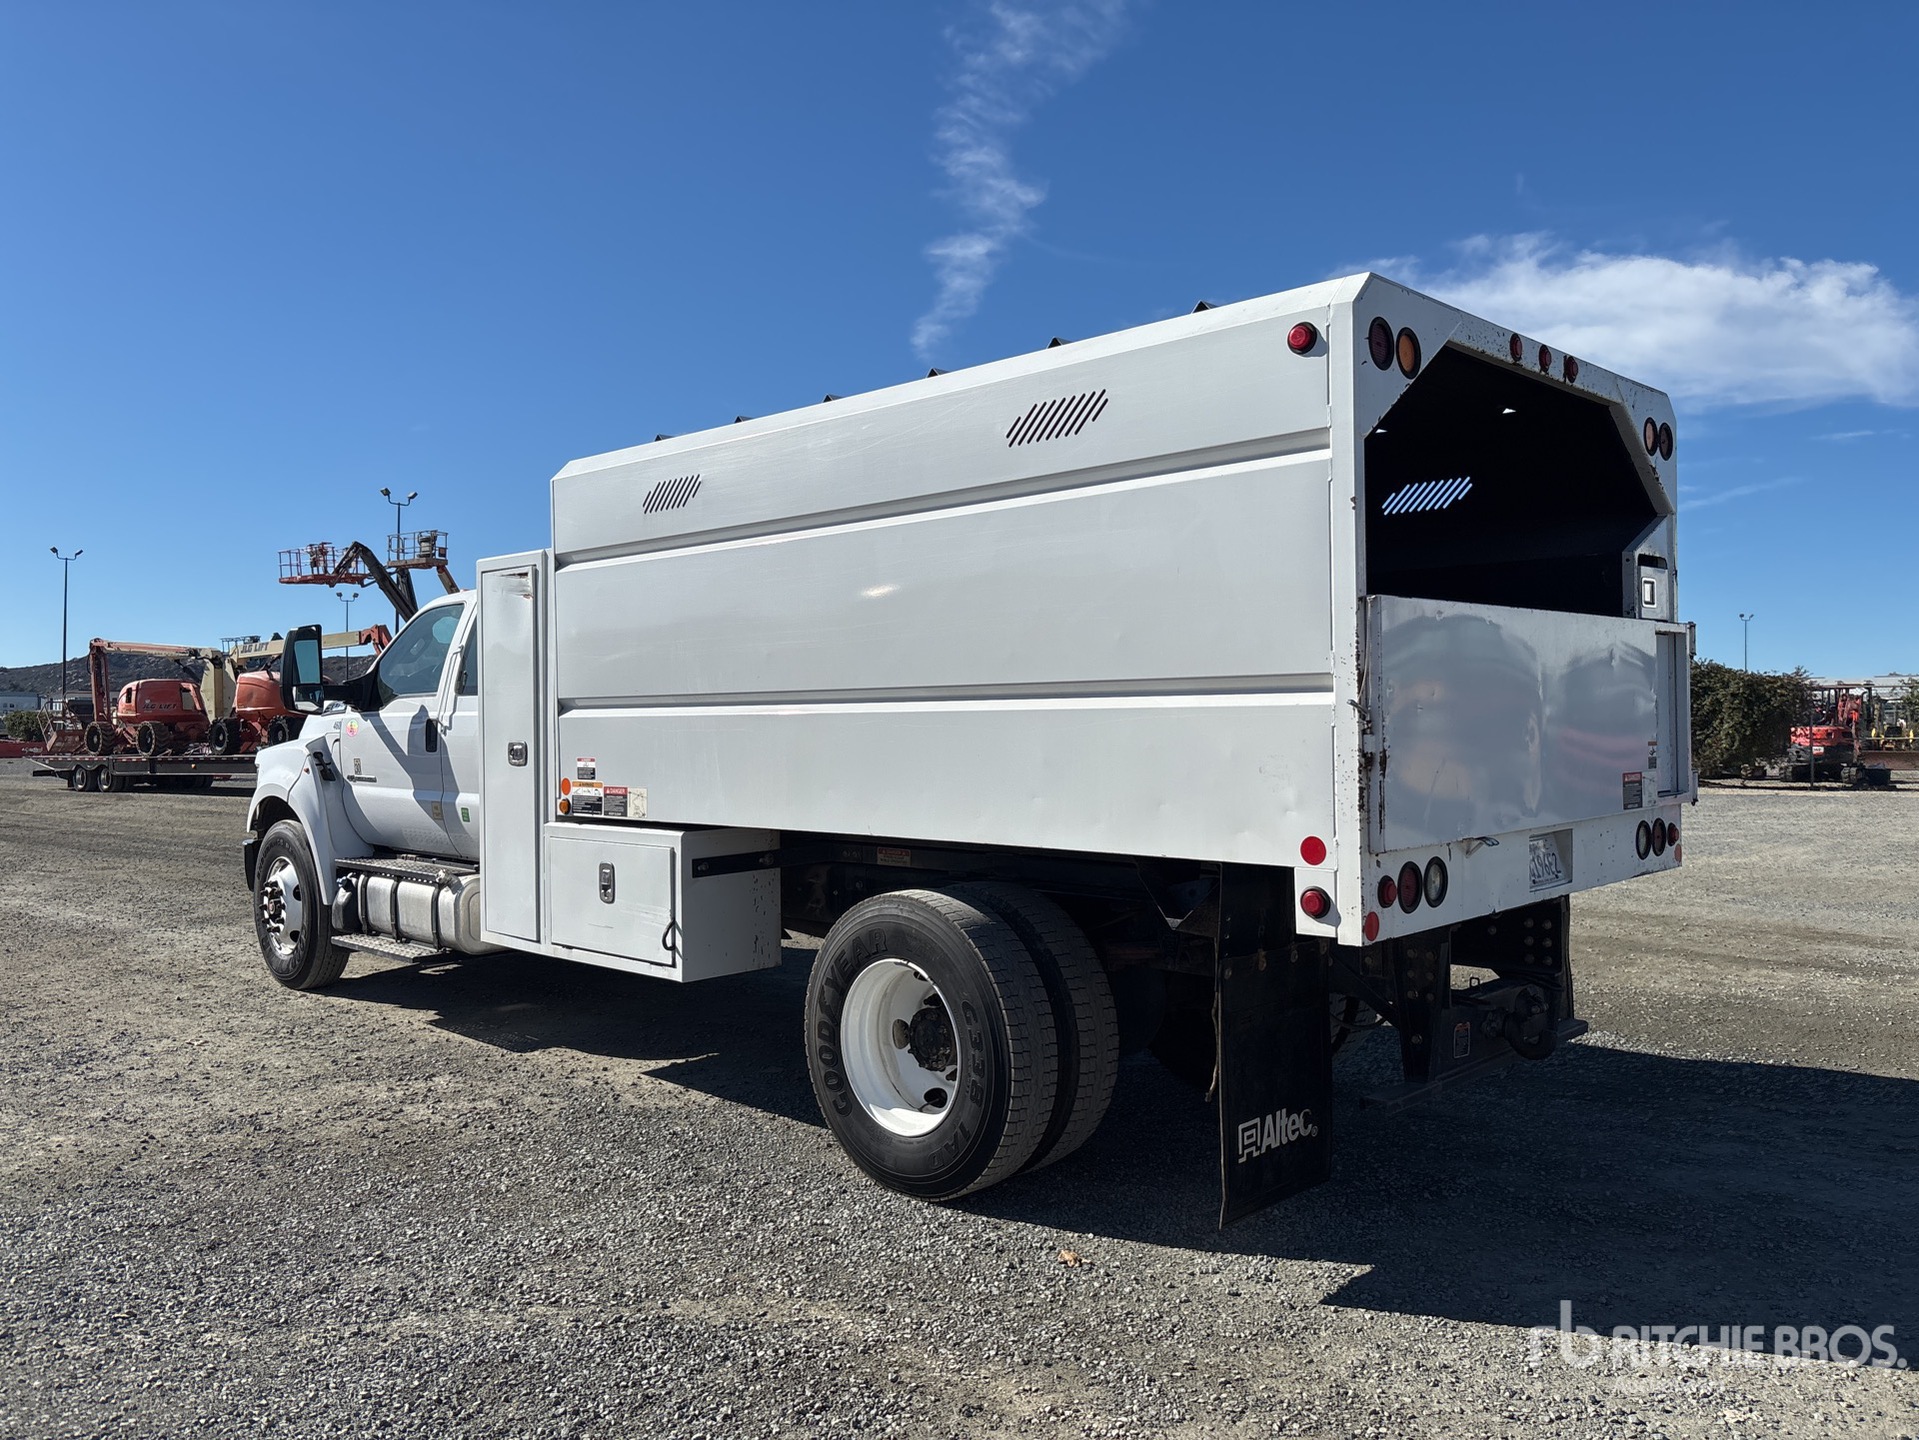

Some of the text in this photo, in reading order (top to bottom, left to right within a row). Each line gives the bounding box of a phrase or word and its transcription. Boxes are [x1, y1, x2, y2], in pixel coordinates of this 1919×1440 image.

[241, 642, 269, 654] JLG LIFT
[1261, 1108, 1313, 1154] Altec
